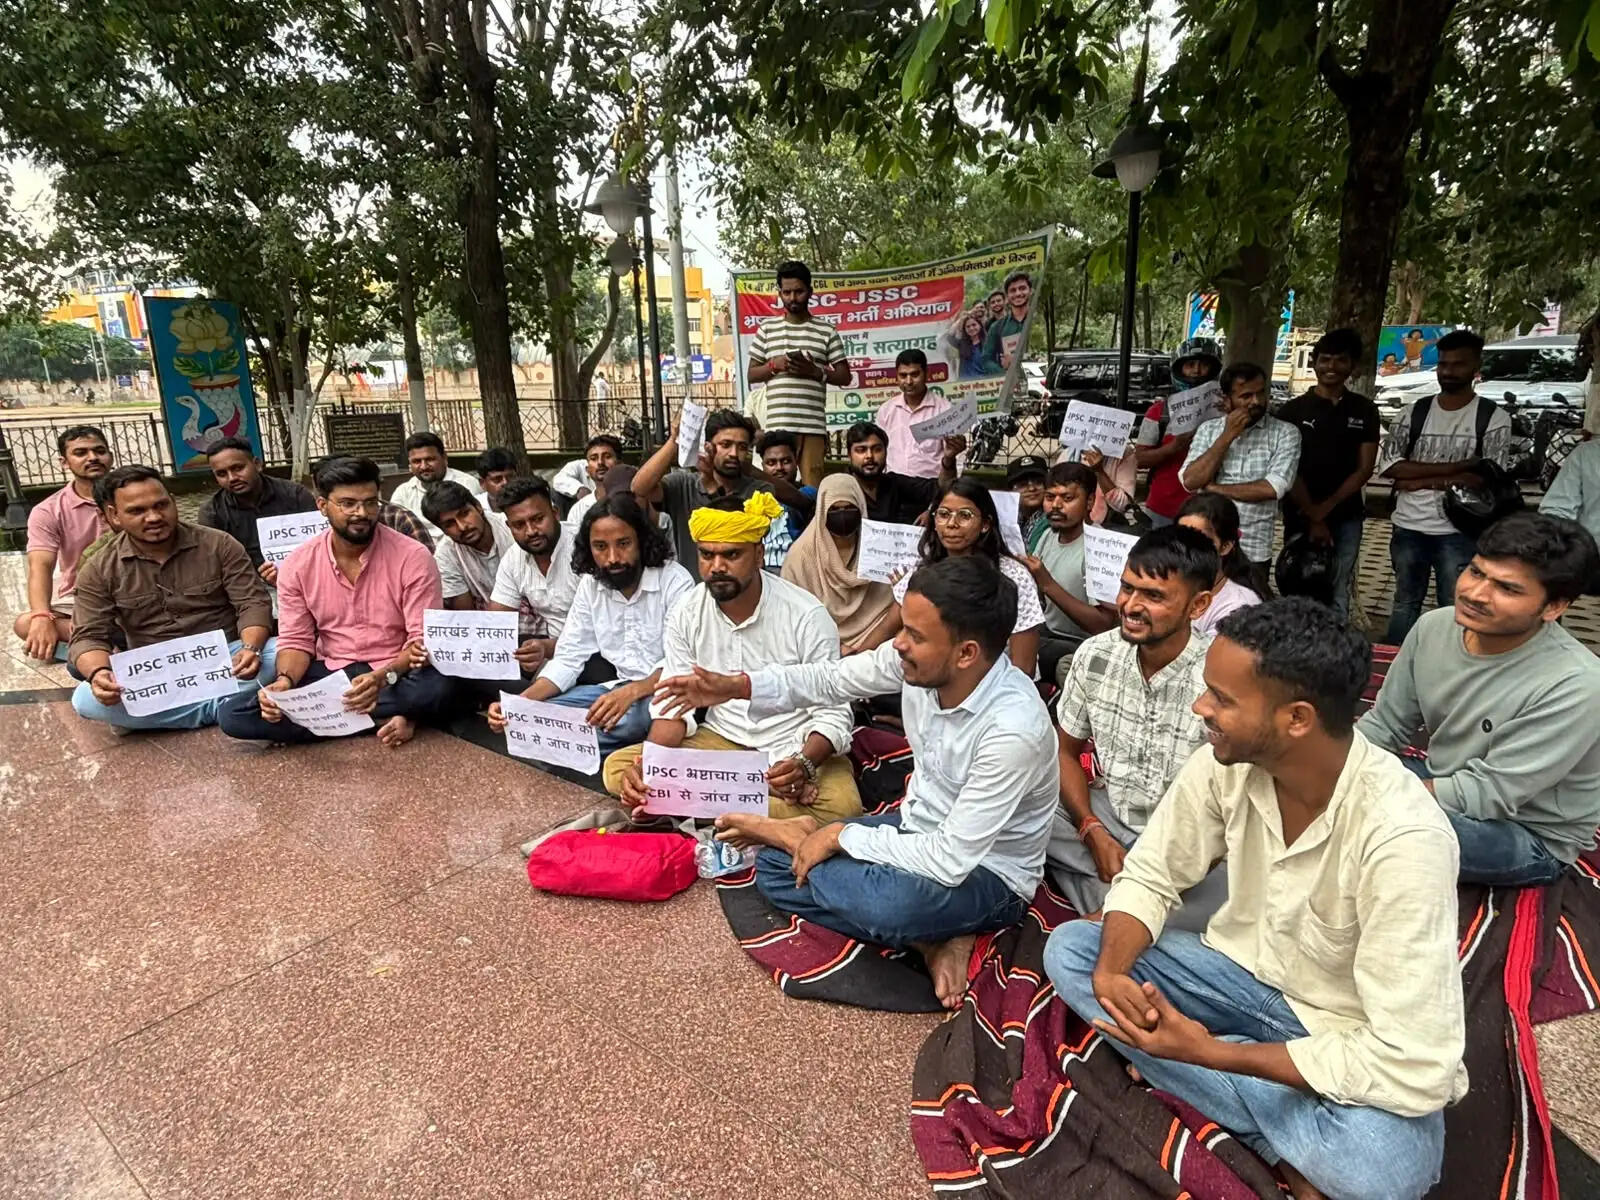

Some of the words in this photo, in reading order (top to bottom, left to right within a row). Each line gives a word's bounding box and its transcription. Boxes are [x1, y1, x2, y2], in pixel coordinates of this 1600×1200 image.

[814, 280, 829, 289] CGL
[847, 305, 879, 322] भर्ती
[883, 301, 952, 320] अभियान
[873, 335, 937, 355] सत्याग्रह
[1068, 412, 1085, 422] JPSC
[269, 527, 297, 540] JPSC
[299, 524, 316, 535] का
[427, 623, 470, 638] झारखंड
[476, 627, 516, 639] सरकार
[128, 658, 163, 677] JPSC
[167, 651, 186, 664] का
[189, 645, 218, 660] सीट
[433, 648, 455, 662] होश
[461, 648, 472, 662] में
[480, 650, 510, 663] आओ
[125, 682, 167, 701] बेचना
[175, 674, 198, 689] बंद
[205, 666, 232, 681] करो
[504, 710, 529, 722] JPSC
[533, 715, 574, 732] भ्रष्टाचार
[578, 724, 594, 735] को
[510, 730, 526, 741] CBI
[531, 732, 541, 745] से
[547, 736, 570, 750] जांच
[576, 743, 596, 756] करो
[646, 765, 678, 778] JPSC
[686, 767, 739, 782] भ्रष्टाचार
[747, 769, 765, 783] को
[648, 789, 671, 798] CBI
[679, 788, 692, 800] से
[700, 790, 730, 803] जांच
[738, 791, 765, 804] करो
